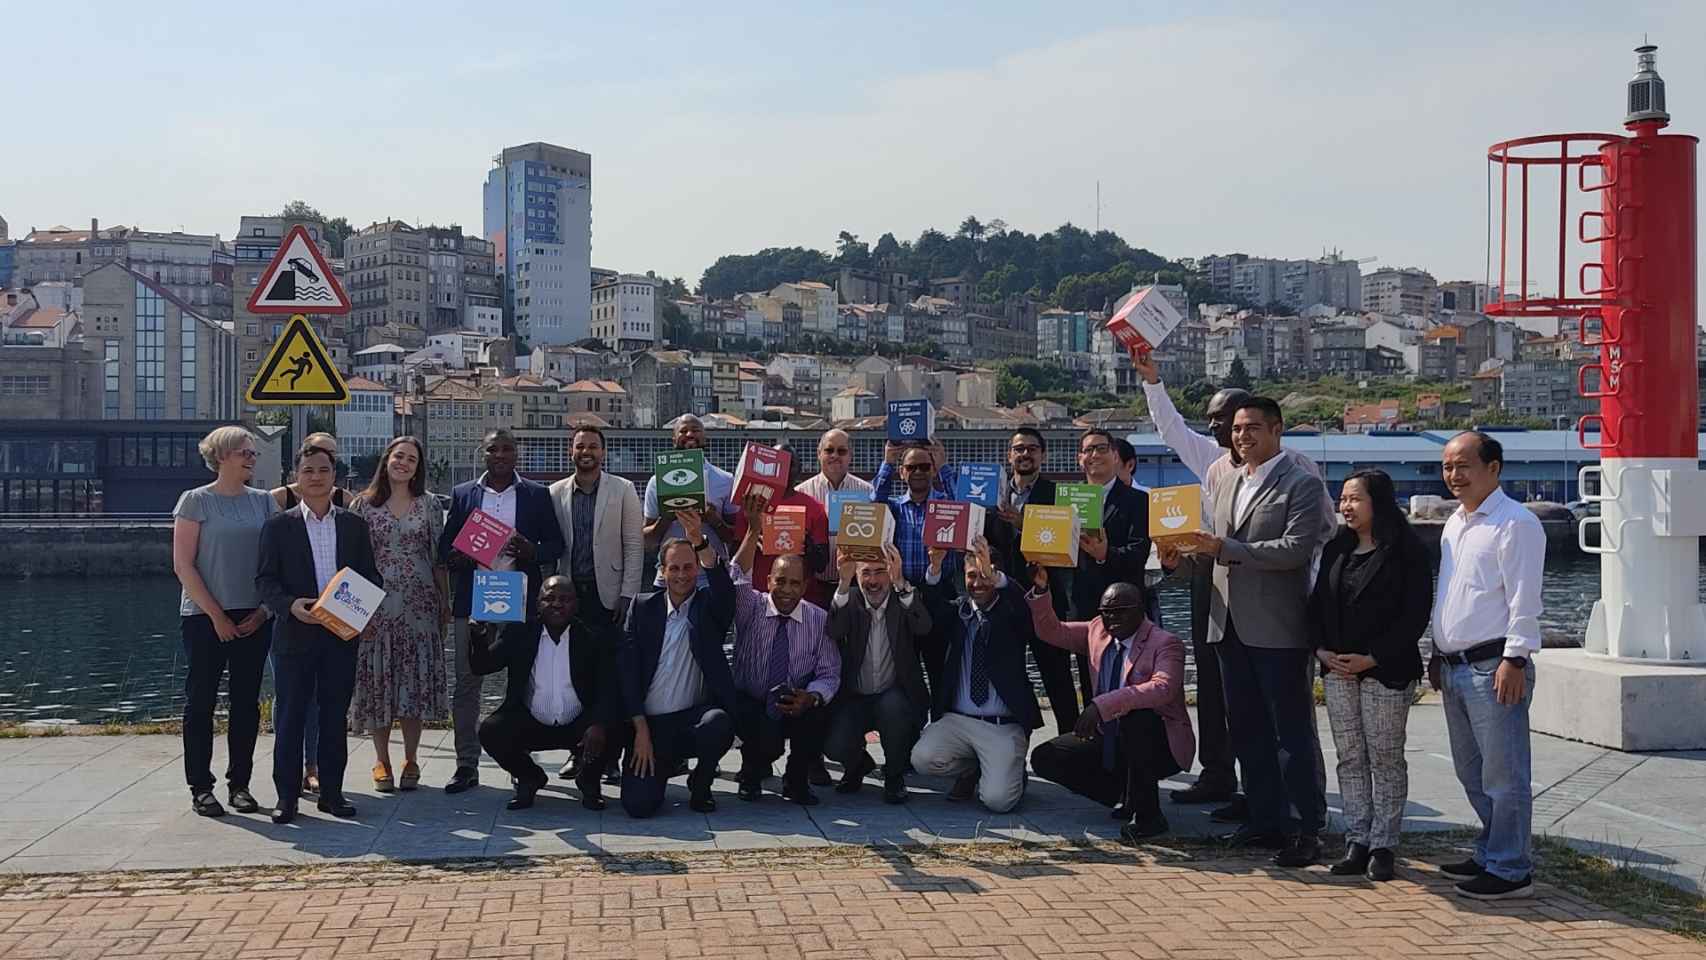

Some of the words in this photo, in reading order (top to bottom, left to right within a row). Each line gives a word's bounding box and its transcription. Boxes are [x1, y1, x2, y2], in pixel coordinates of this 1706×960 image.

[1609, 345, 1621, 389] MSM
[889, 403, 898, 412] 17
[749, 444, 756, 453] 4
[657, 455, 667, 465] 13
[961, 465, 970, 475] 16
[1058, 486, 1068, 496] 15
[1152, 492, 1160, 504] 2
[844, 504, 853, 515] 12
[929, 503, 935, 513] 8
[1027, 508, 1034, 518] 7
[477, 575, 486, 586] 14
